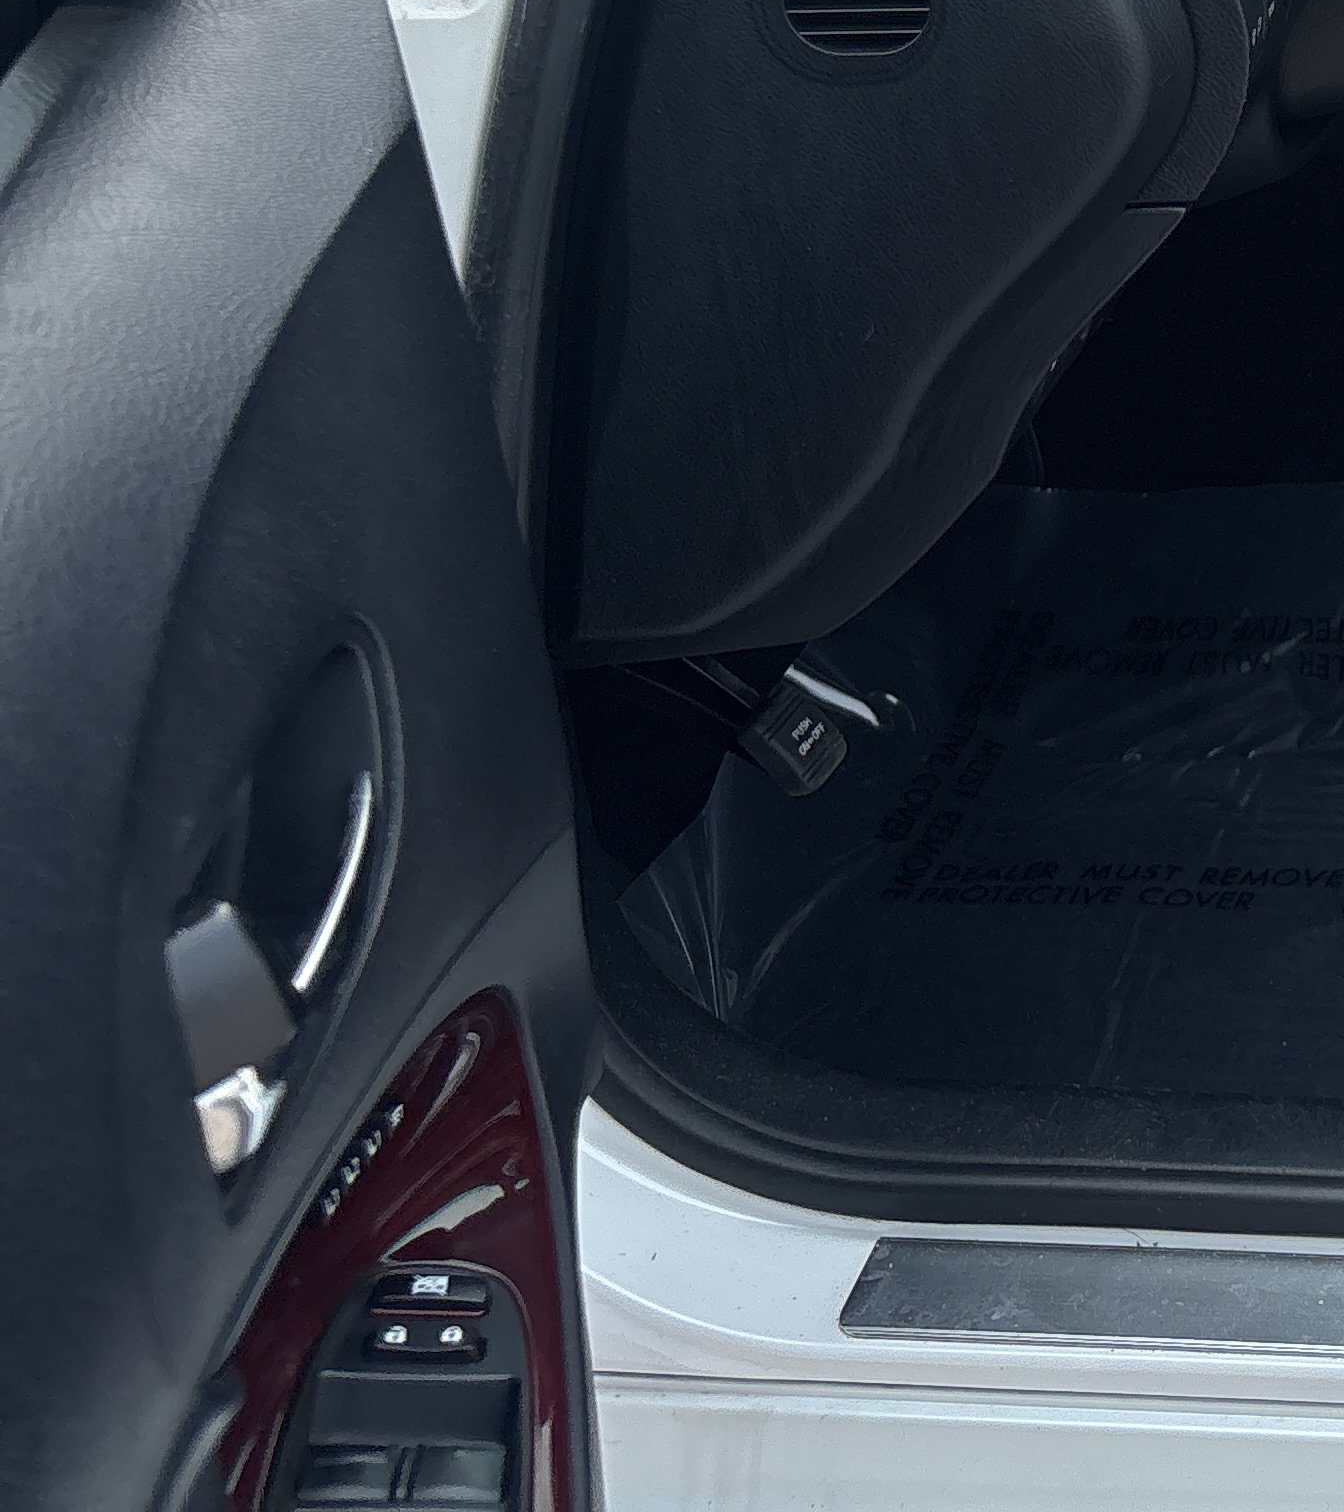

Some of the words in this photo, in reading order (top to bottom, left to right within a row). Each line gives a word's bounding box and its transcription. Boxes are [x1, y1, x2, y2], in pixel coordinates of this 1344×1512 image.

[792, 717, 813, 741] PUSH
[935, 863, 1060, 883] DEALER
[1079, 863, 1183, 882] MUST
[917, 886, 1124, 905] PROTECTIVE
[1138, 888, 1255, 911] COVER
